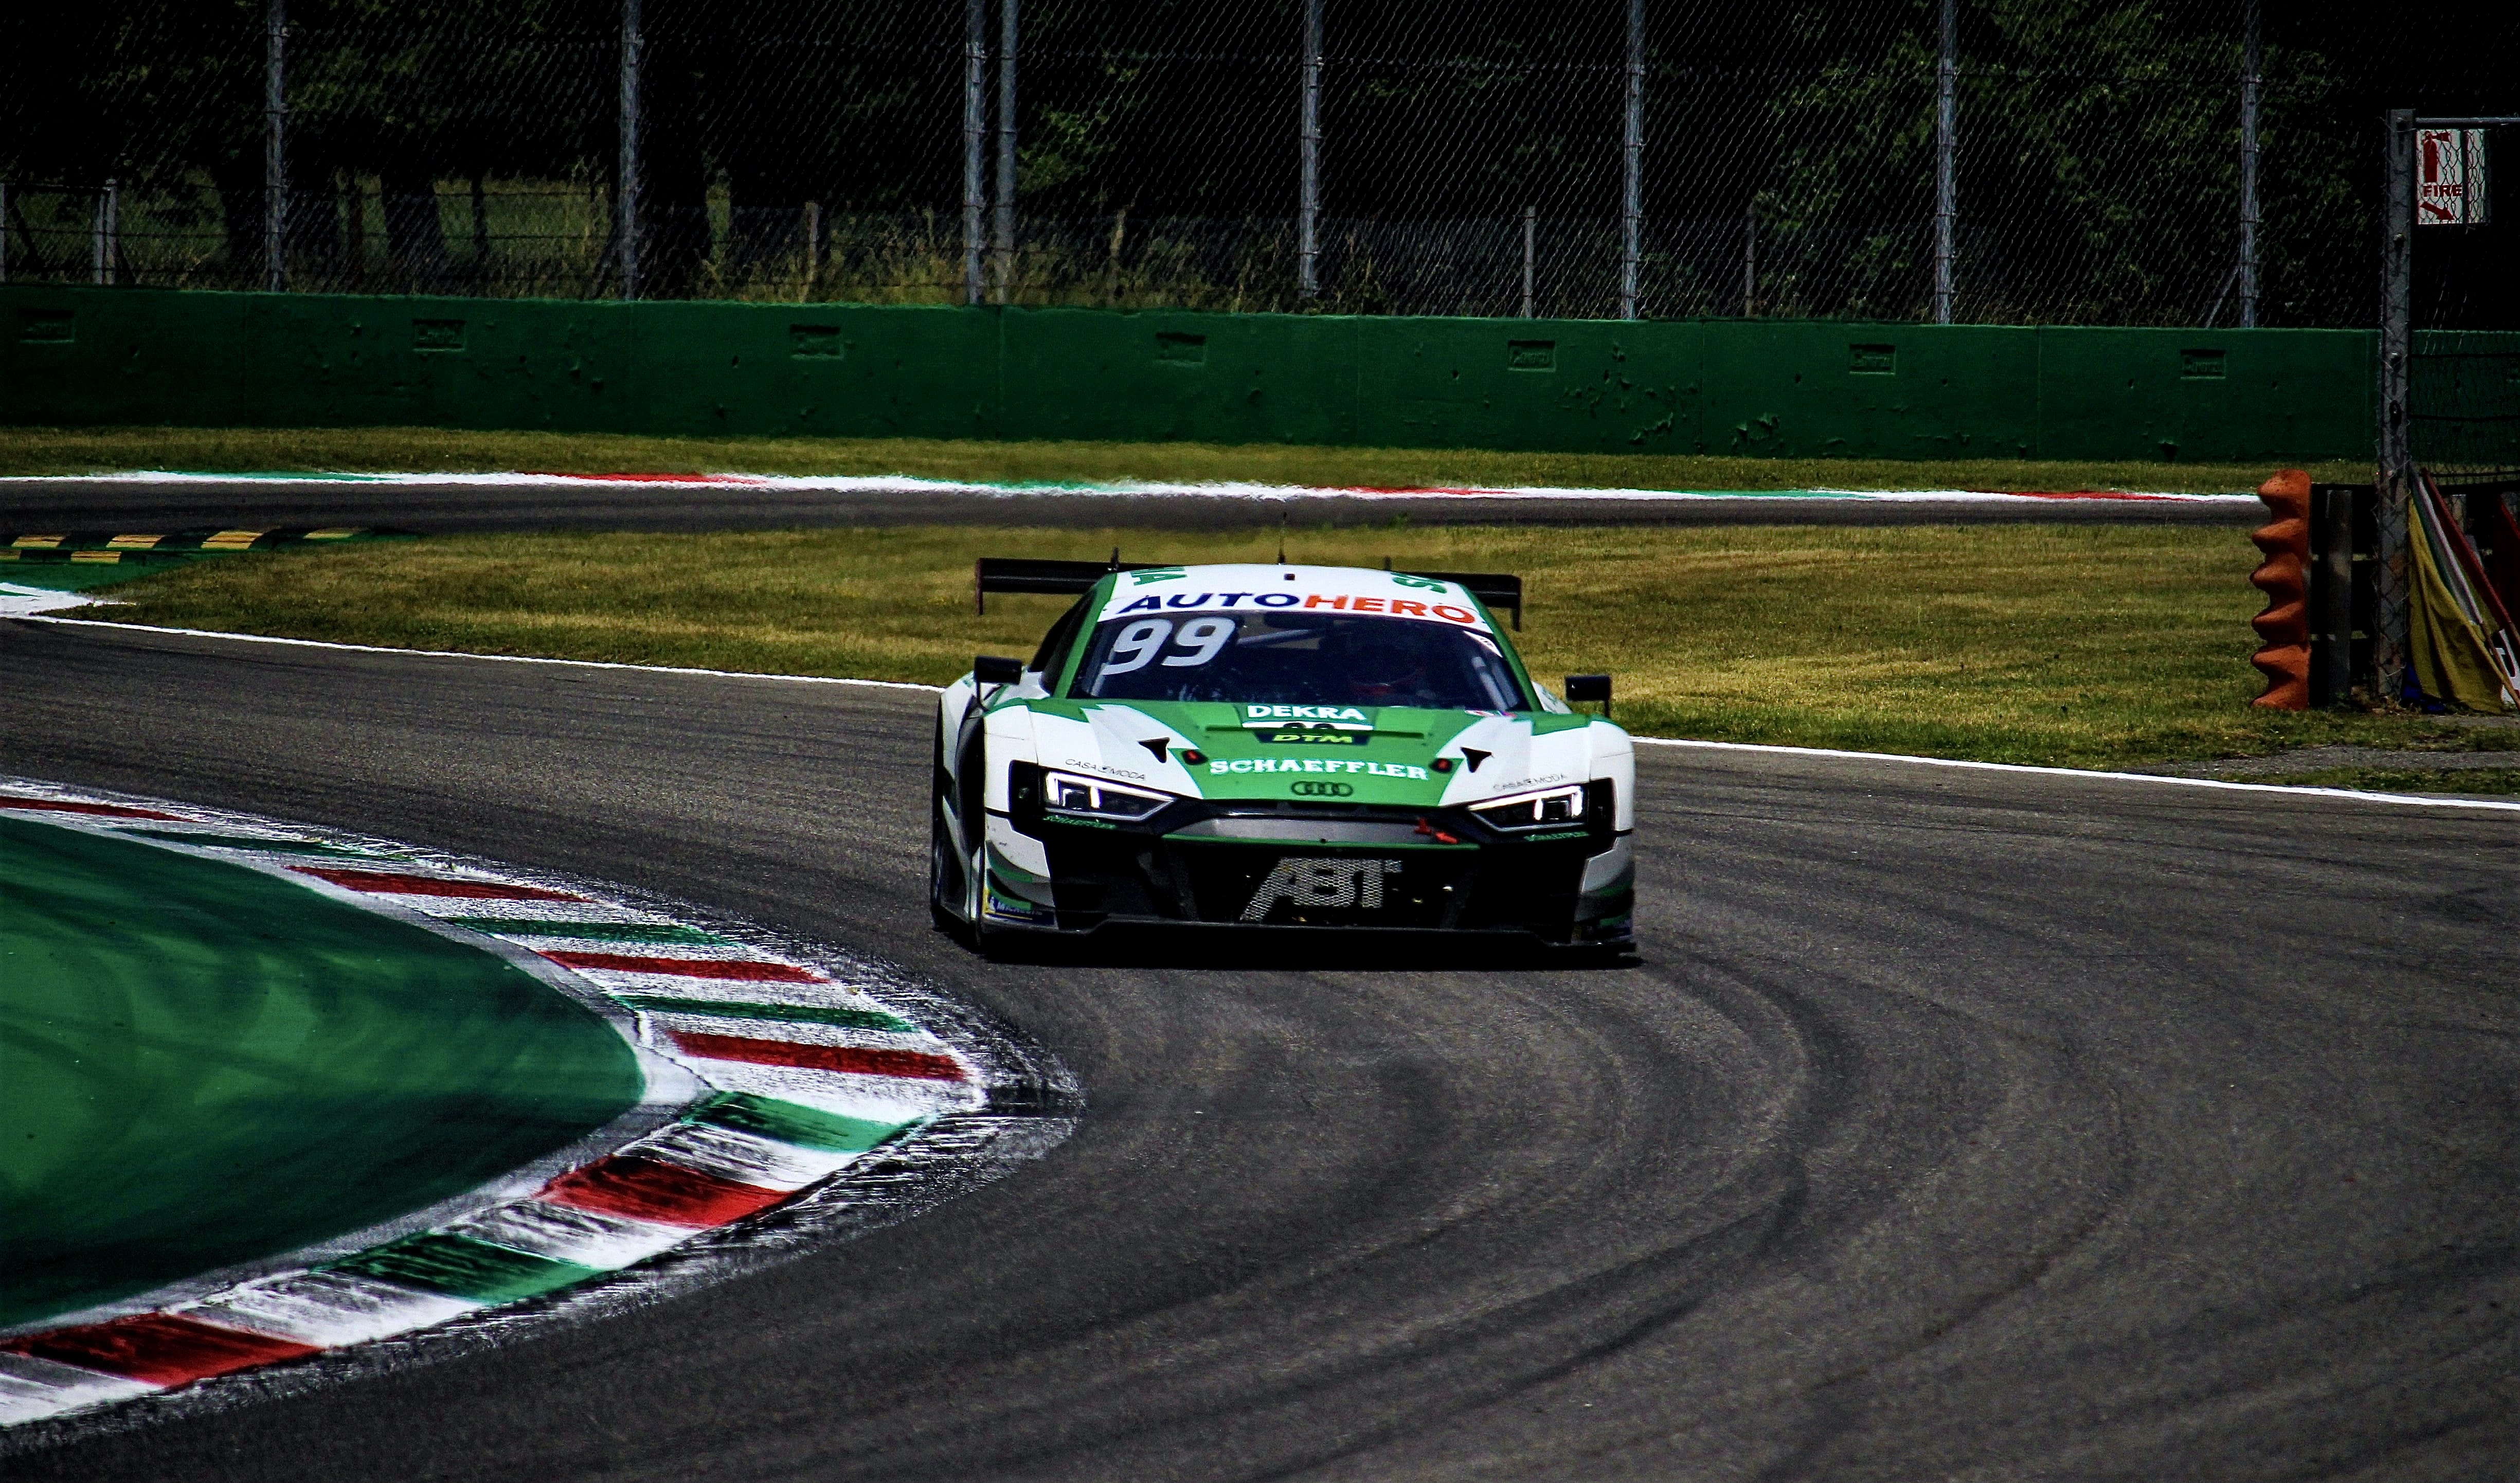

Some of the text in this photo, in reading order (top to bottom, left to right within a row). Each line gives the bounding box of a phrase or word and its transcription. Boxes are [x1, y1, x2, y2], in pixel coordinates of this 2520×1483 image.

[2423, 184, 2462, 198] FIRE
[1115, 592, 1475, 623] AUTOHERO
[1100, 617, 1235, 675] 99
[1247, 705, 1367, 720] DEKRA
[1272, 734, 1354, 744] DTM
[1209, 758, 1429, 780] SCHAEFFLER
[1239, 856, 1403, 922] ABT
